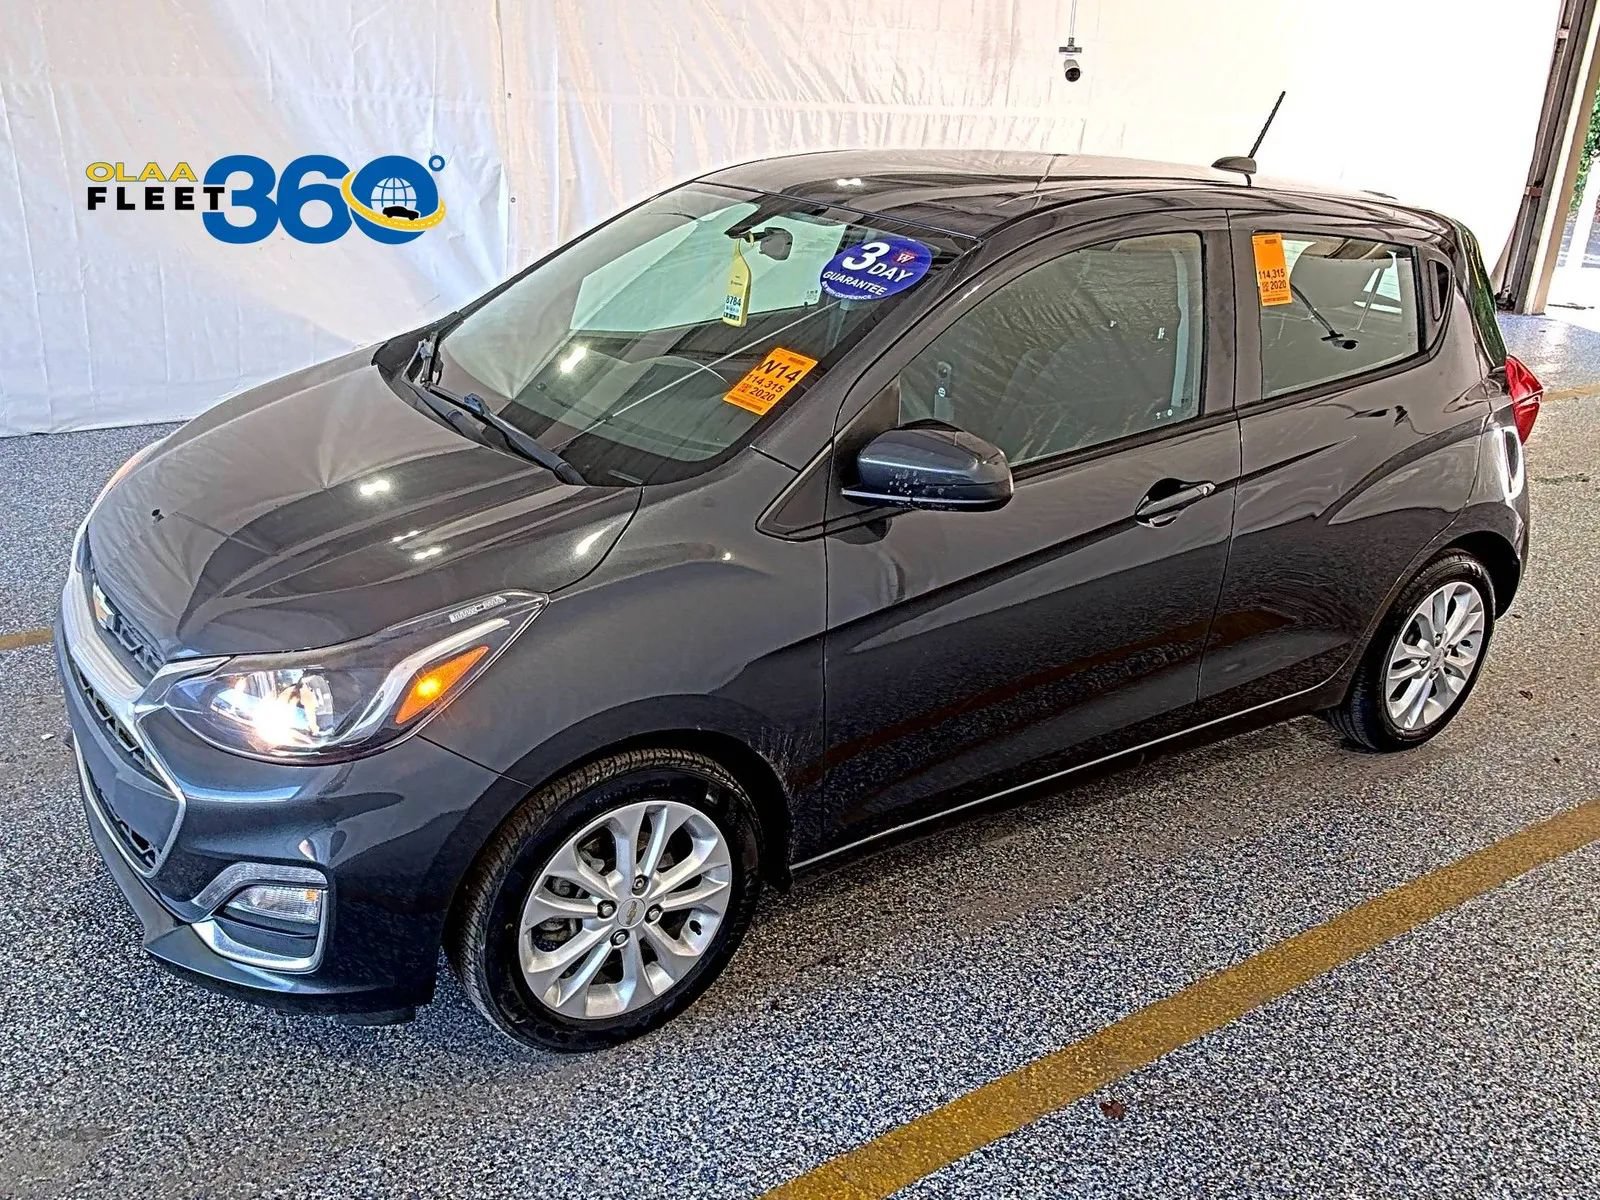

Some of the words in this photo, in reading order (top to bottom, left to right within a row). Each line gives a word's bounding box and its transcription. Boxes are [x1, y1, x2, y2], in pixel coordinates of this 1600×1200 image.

[842, 242, 890, 270] 3
[867, 262, 914, 283] DAY
[1258, 268, 1285, 279] 114,315
[822, 271, 888, 295] GUARANTEE
[1270, 279, 1287, 290] 2020
[745, 373, 785, 393] 114,315
[749, 386, 776, 402] 2020
